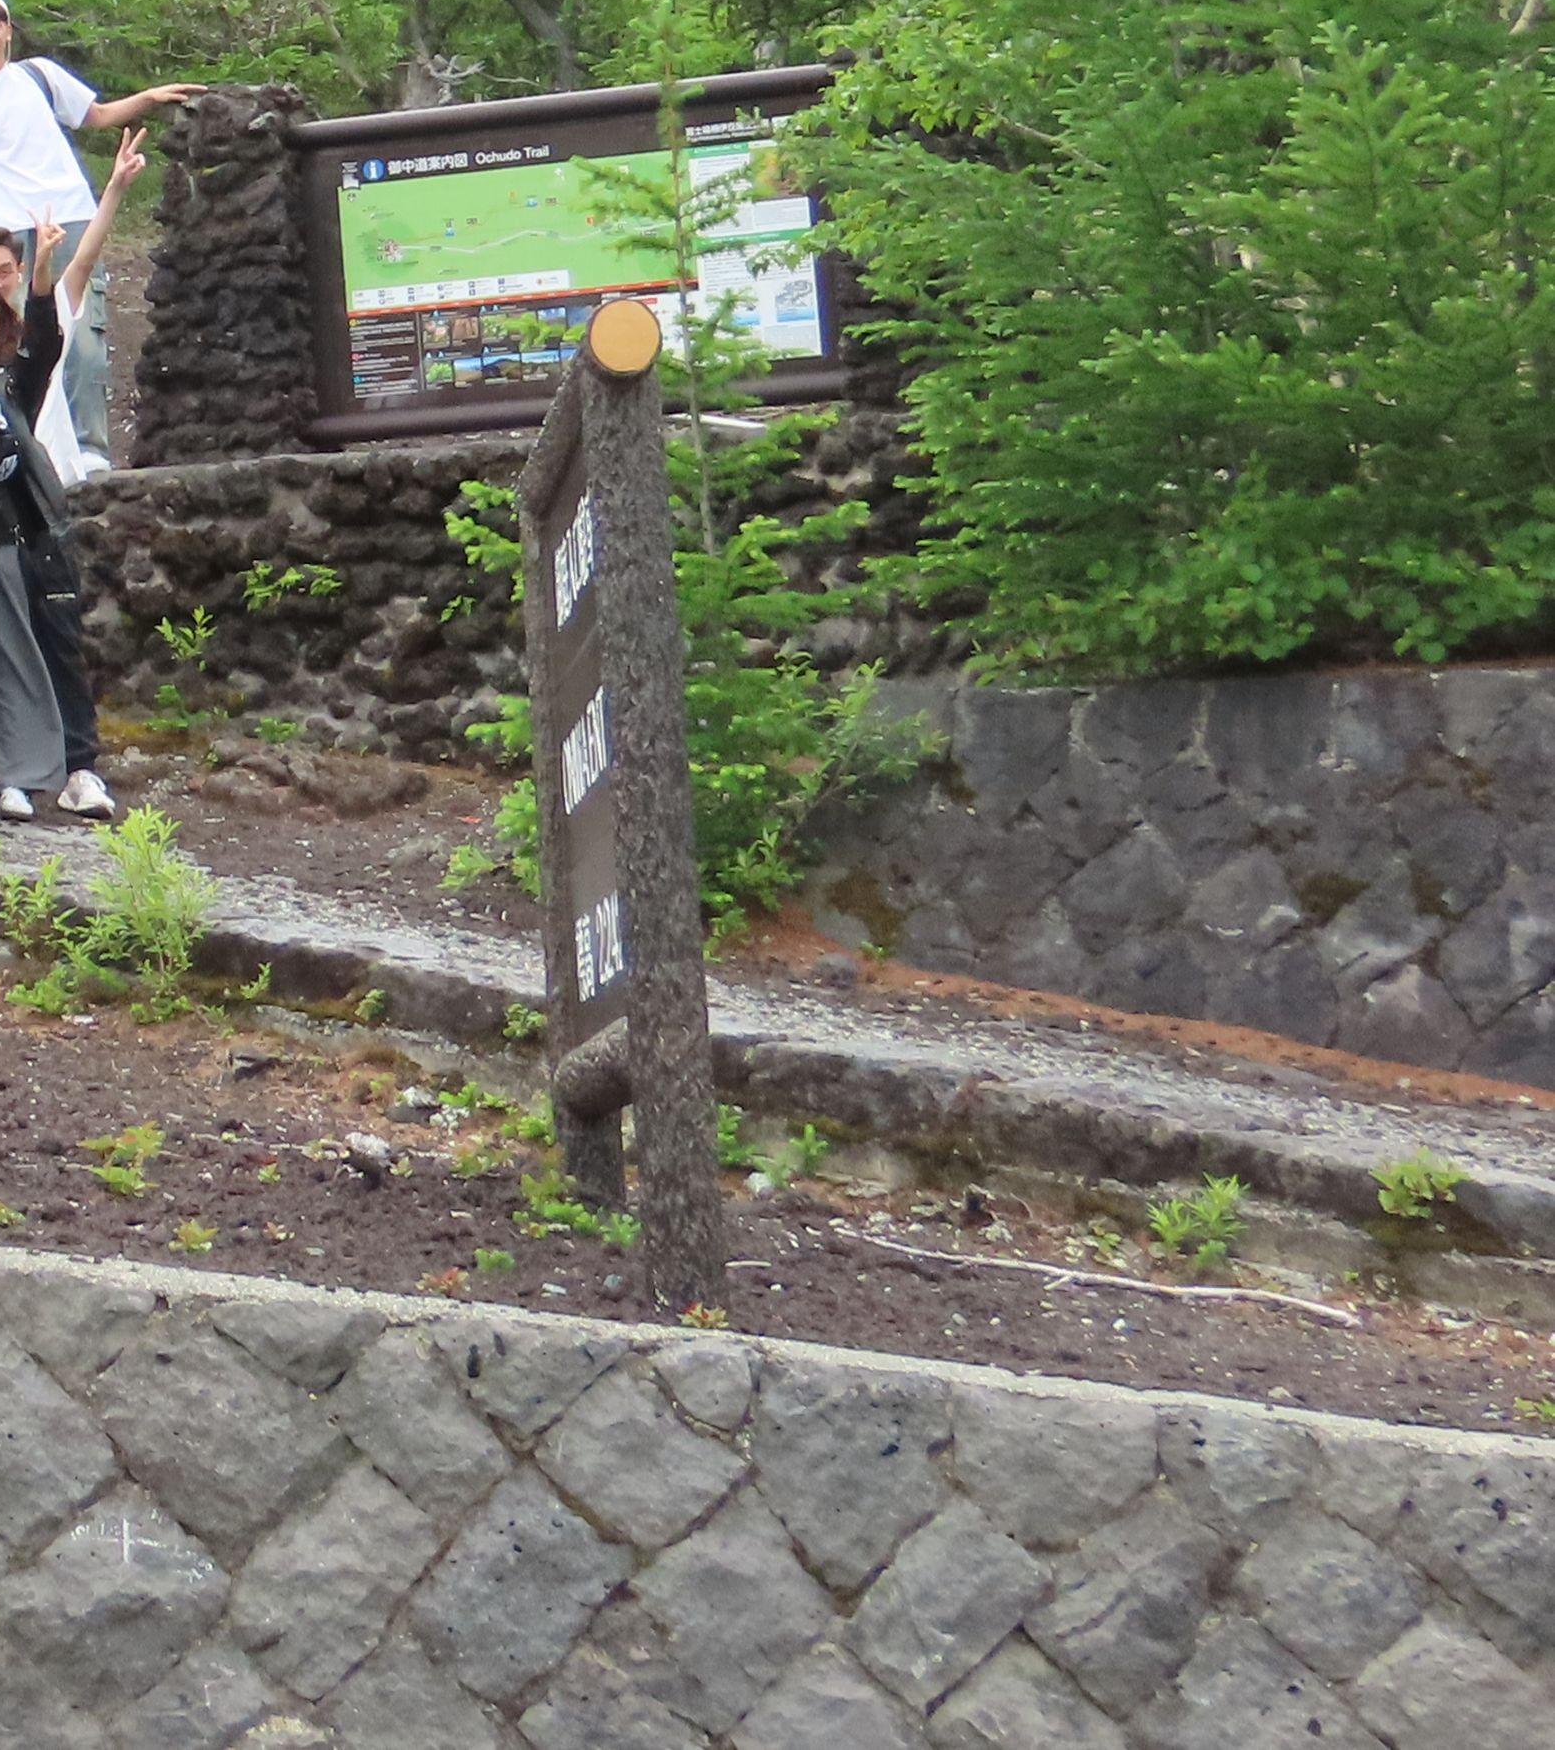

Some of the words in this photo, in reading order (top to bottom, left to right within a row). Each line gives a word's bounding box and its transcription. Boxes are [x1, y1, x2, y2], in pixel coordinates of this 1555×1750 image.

[388, 152, 469, 176] 御中道案内図
[474, 148, 523, 166] Ochudo
[522, 145, 550, 160] Trail
